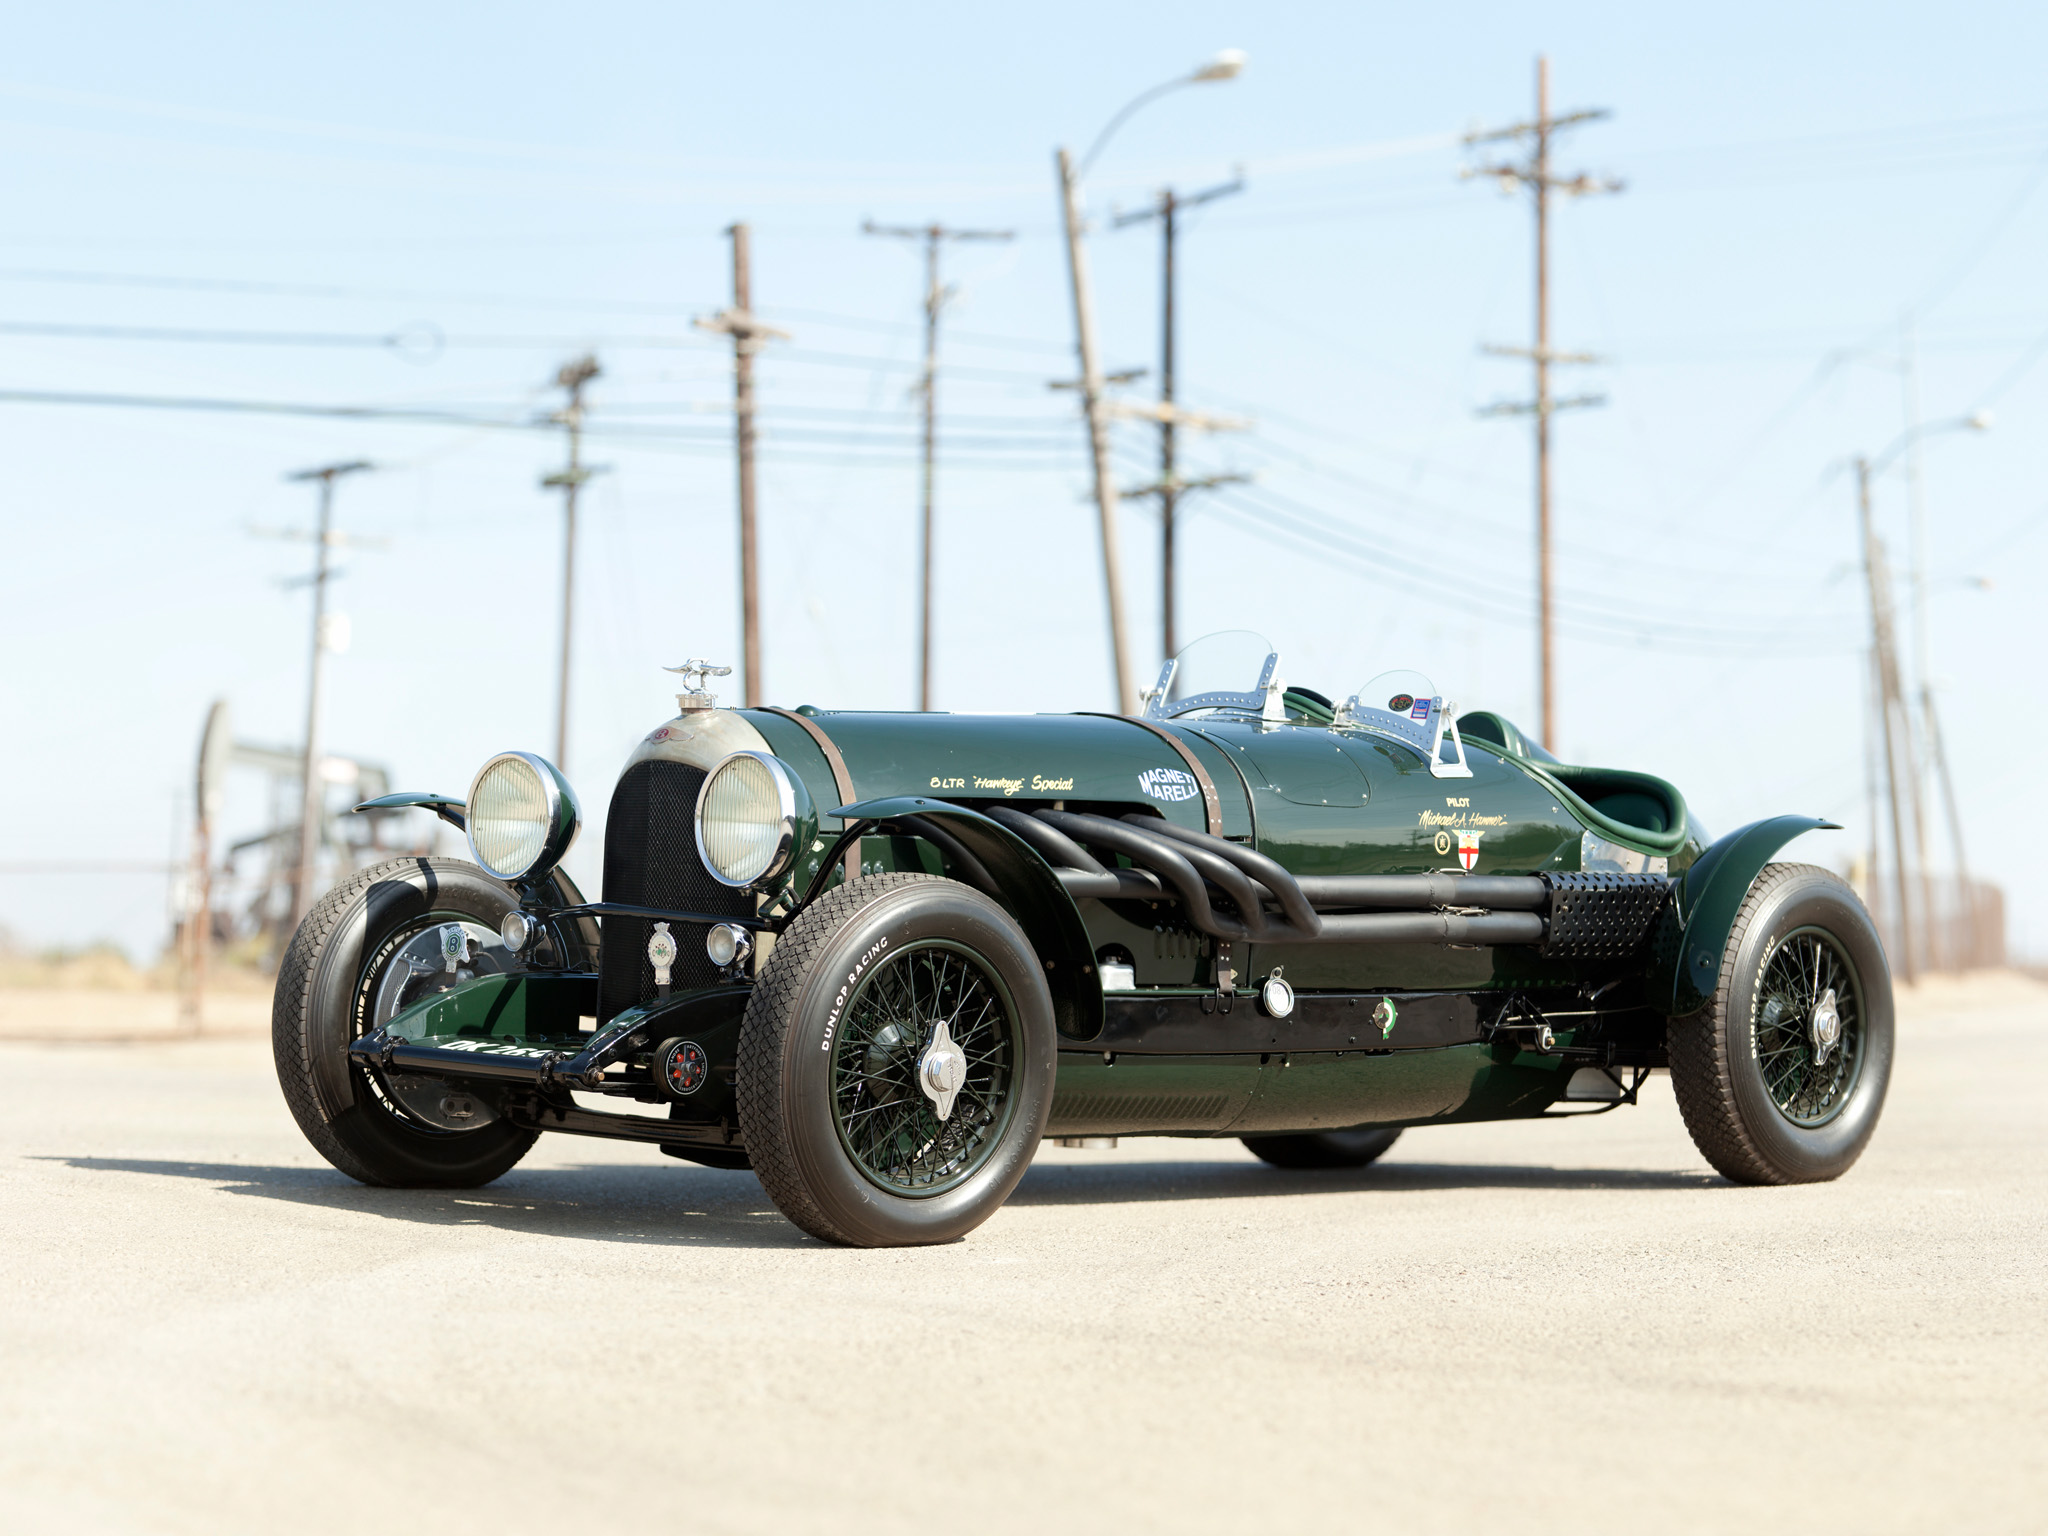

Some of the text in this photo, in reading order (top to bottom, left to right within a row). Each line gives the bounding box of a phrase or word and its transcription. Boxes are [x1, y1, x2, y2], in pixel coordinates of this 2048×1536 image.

[1031, 775, 1073, 792] Special
[1446, 797, 1470, 808] PILOT
[822, 936, 888, 1052] DUNLOP RACING
[1750, 935, 1775, 1060] DUNLOP RACING
